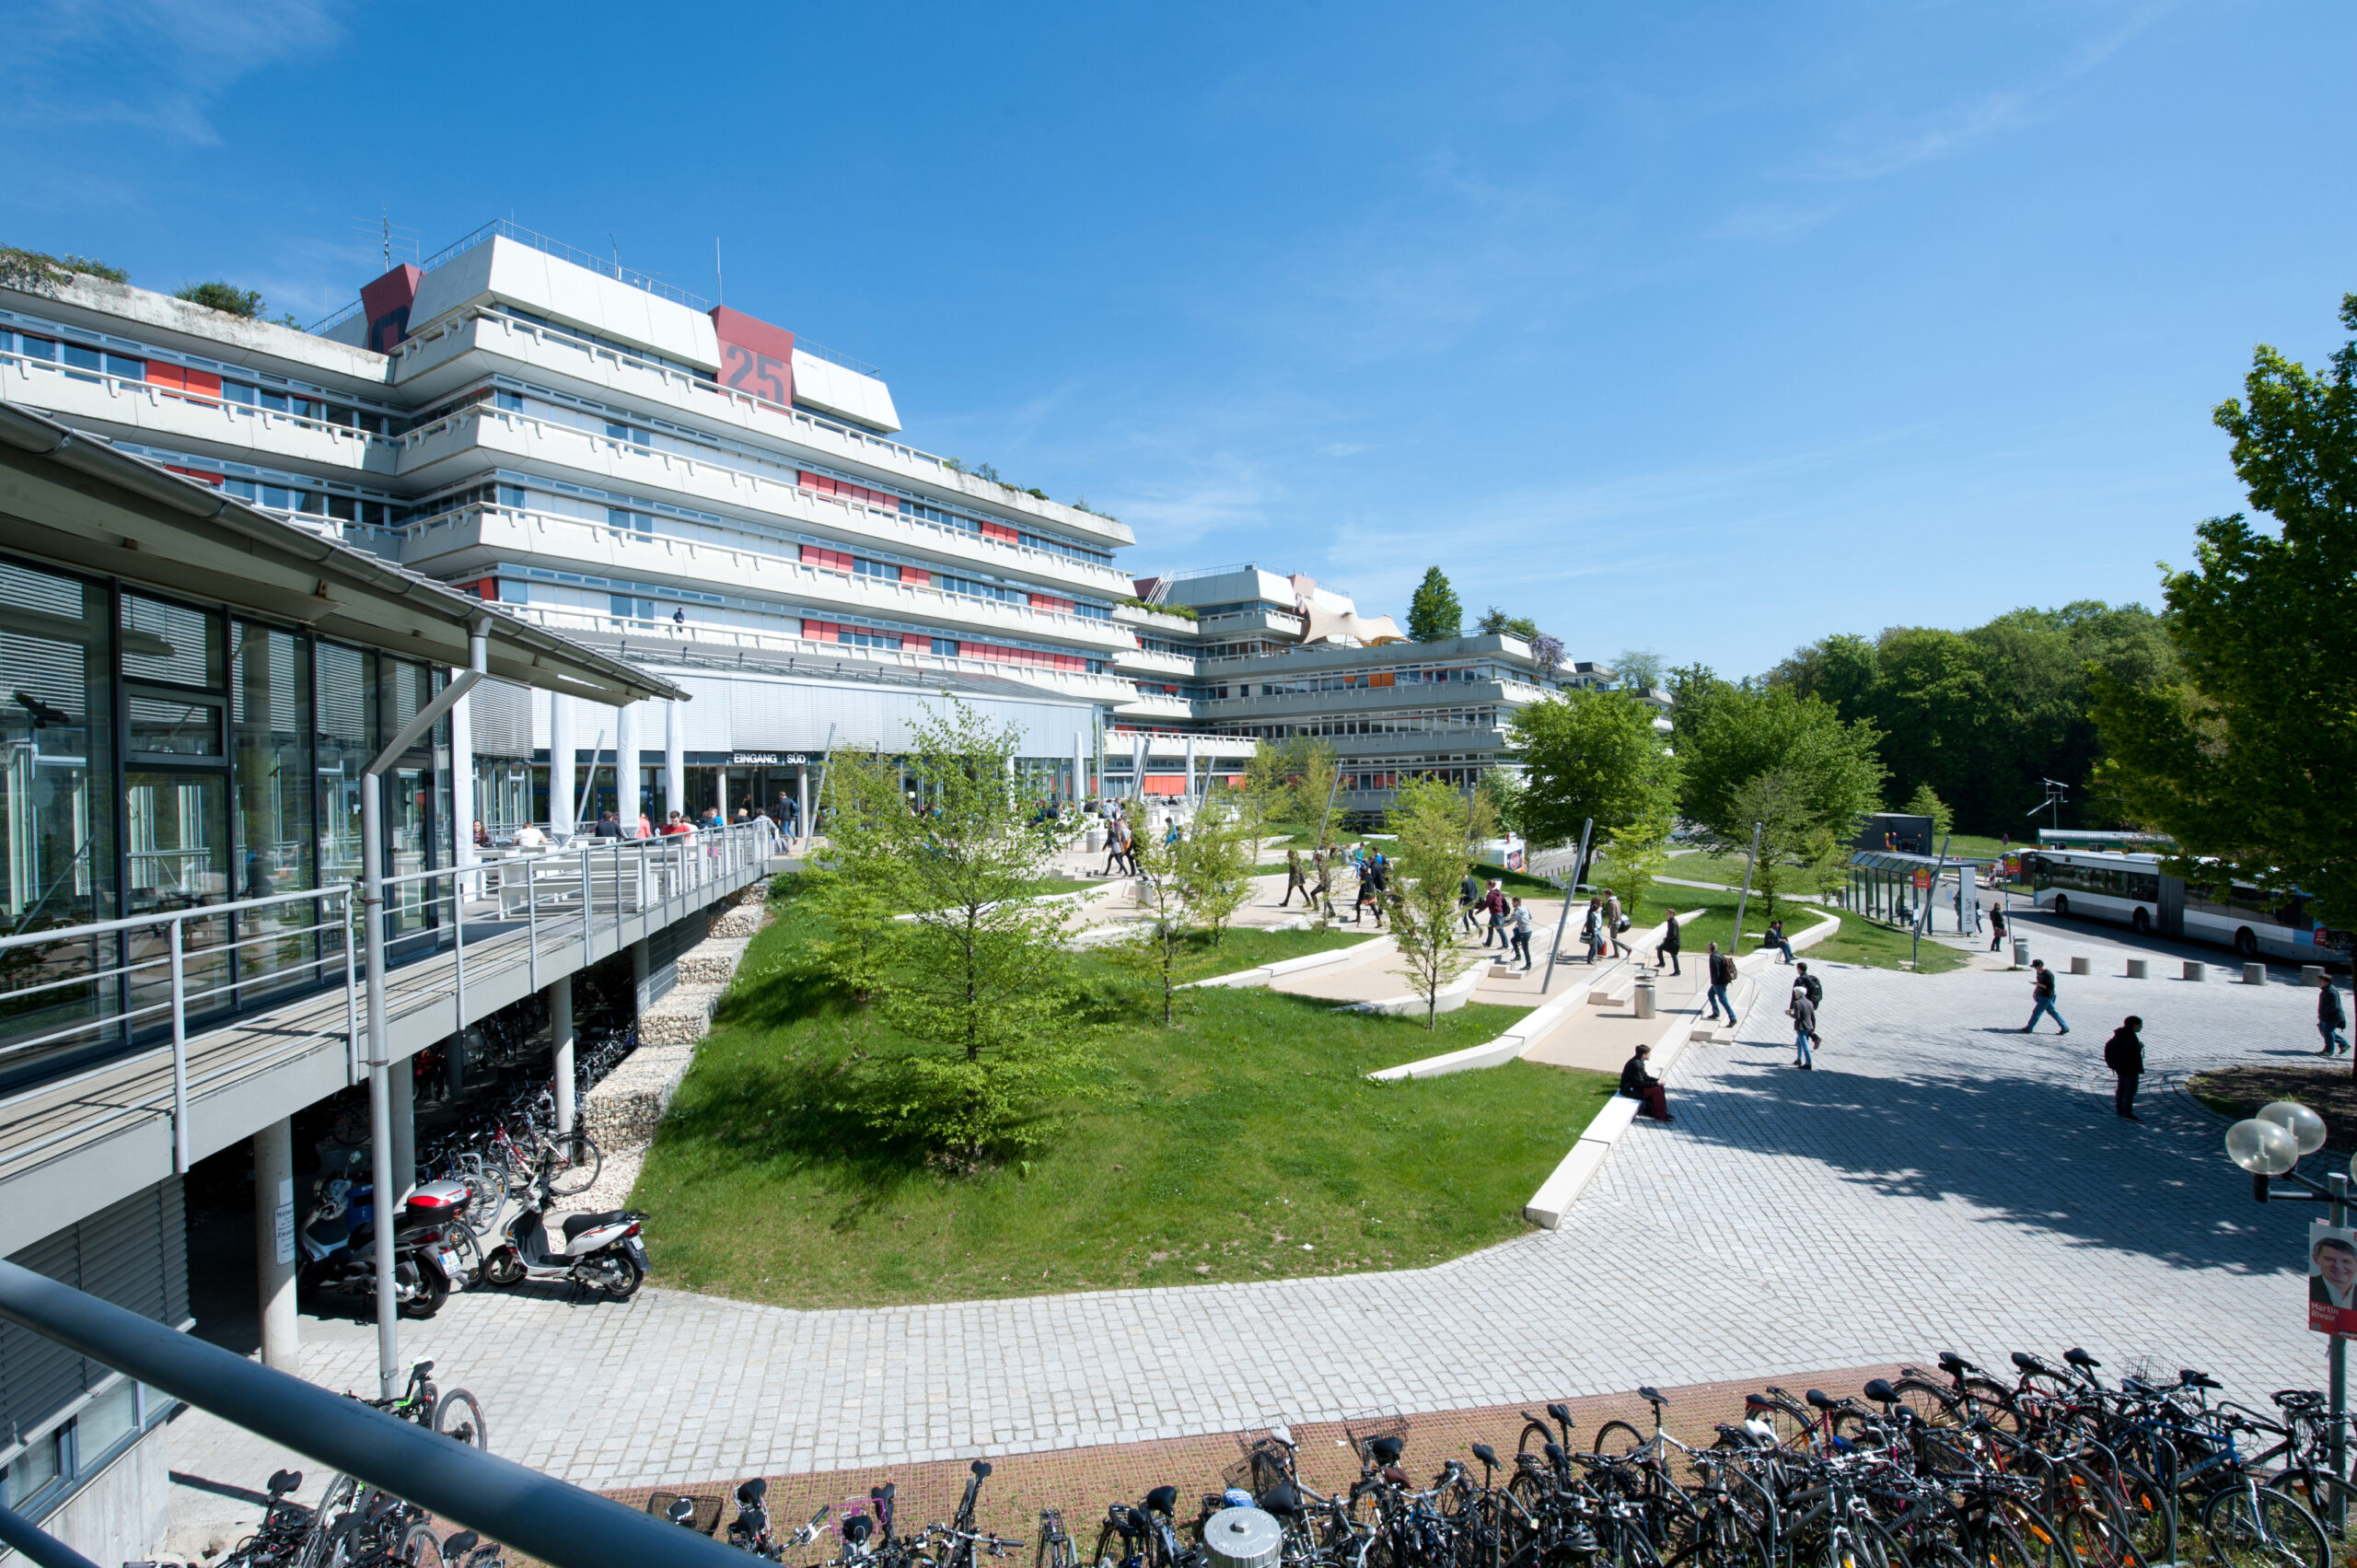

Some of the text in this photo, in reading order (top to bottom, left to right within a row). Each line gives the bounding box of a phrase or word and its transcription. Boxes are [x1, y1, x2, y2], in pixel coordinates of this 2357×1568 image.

[726, 343, 784, 405] 25
[734, 752, 807, 764] EINGANG SÜD
[2311, 1302, 2339, 1315] Martin
[2311, 1309, 2336, 1321] Rivoir
